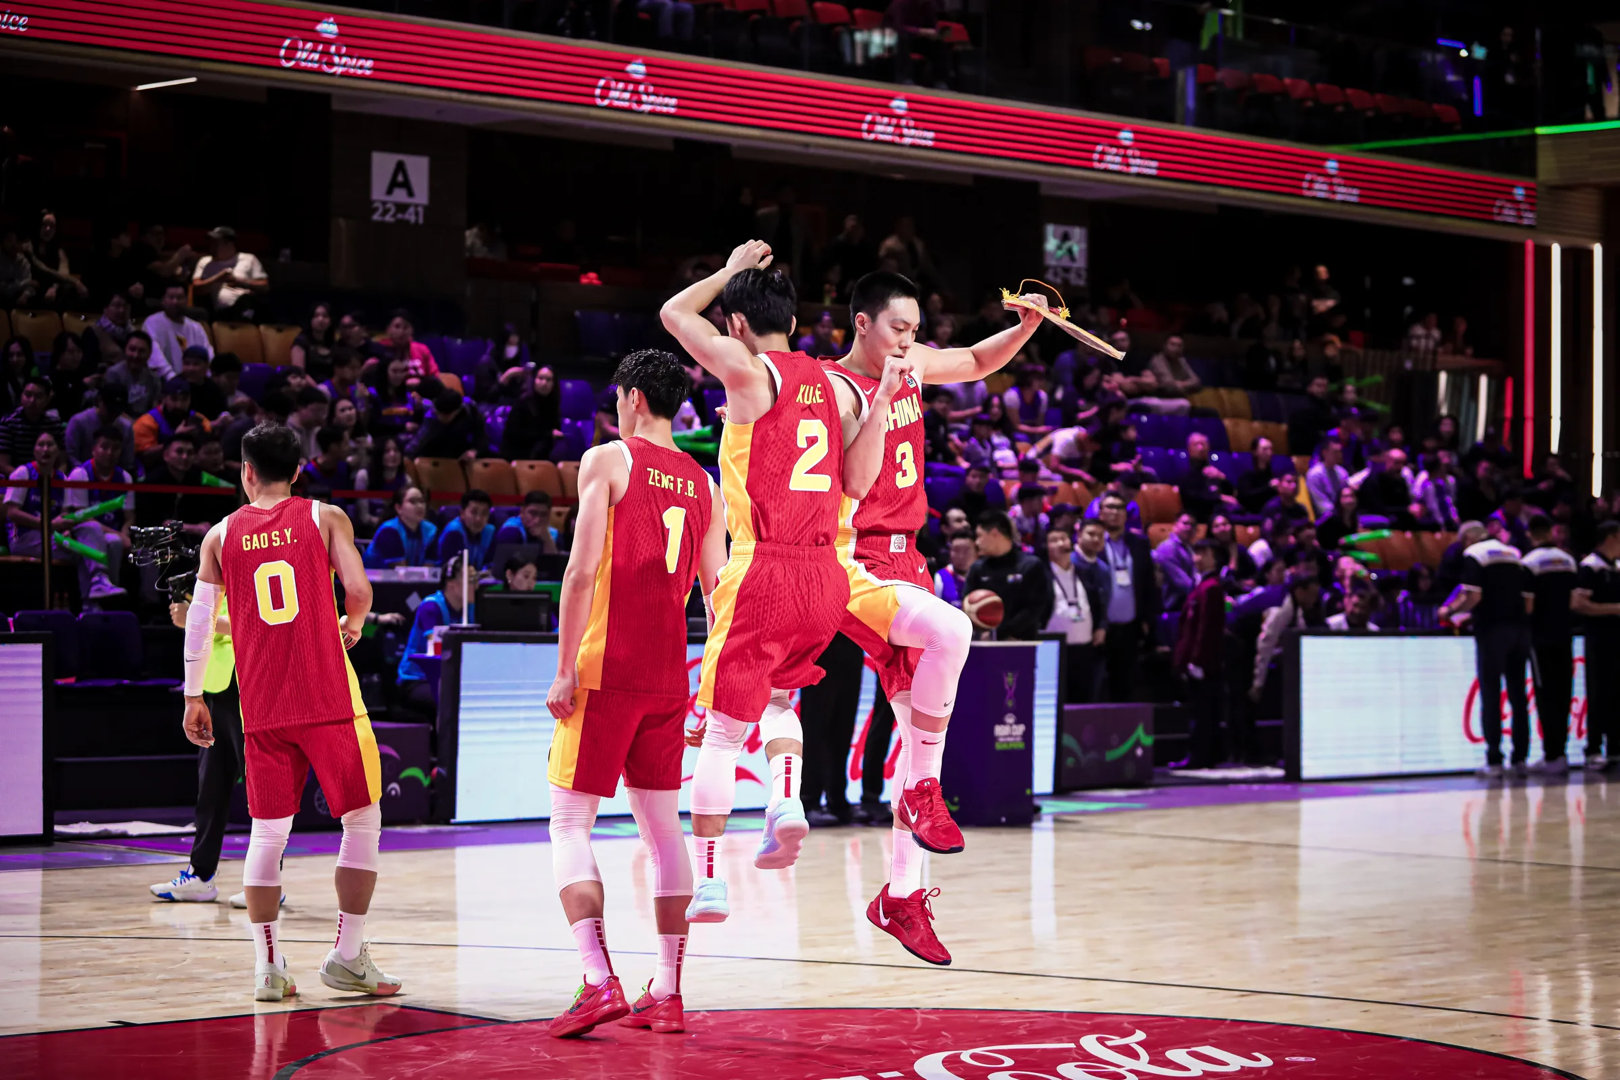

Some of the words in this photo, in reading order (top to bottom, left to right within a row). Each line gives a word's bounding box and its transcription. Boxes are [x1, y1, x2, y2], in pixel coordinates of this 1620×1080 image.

[0, 9, 29, 31] ice
[279, 36, 323, 69] Old
[322, 43, 374, 77] Spice
[385, 159, 416, 198] A
[371, 202, 424, 225] 22-41
[789, 419, 832, 493] 2
[895, 440, 918, 489] 3
[646, 467, 674, 491] ZENG
[676, 477, 698, 499] F.B.
[242, 532, 269, 551] GAO
[271, 527, 298, 547] S.Y.
[662, 505, 687, 574] 1
[253, 559, 300, 626] 0
